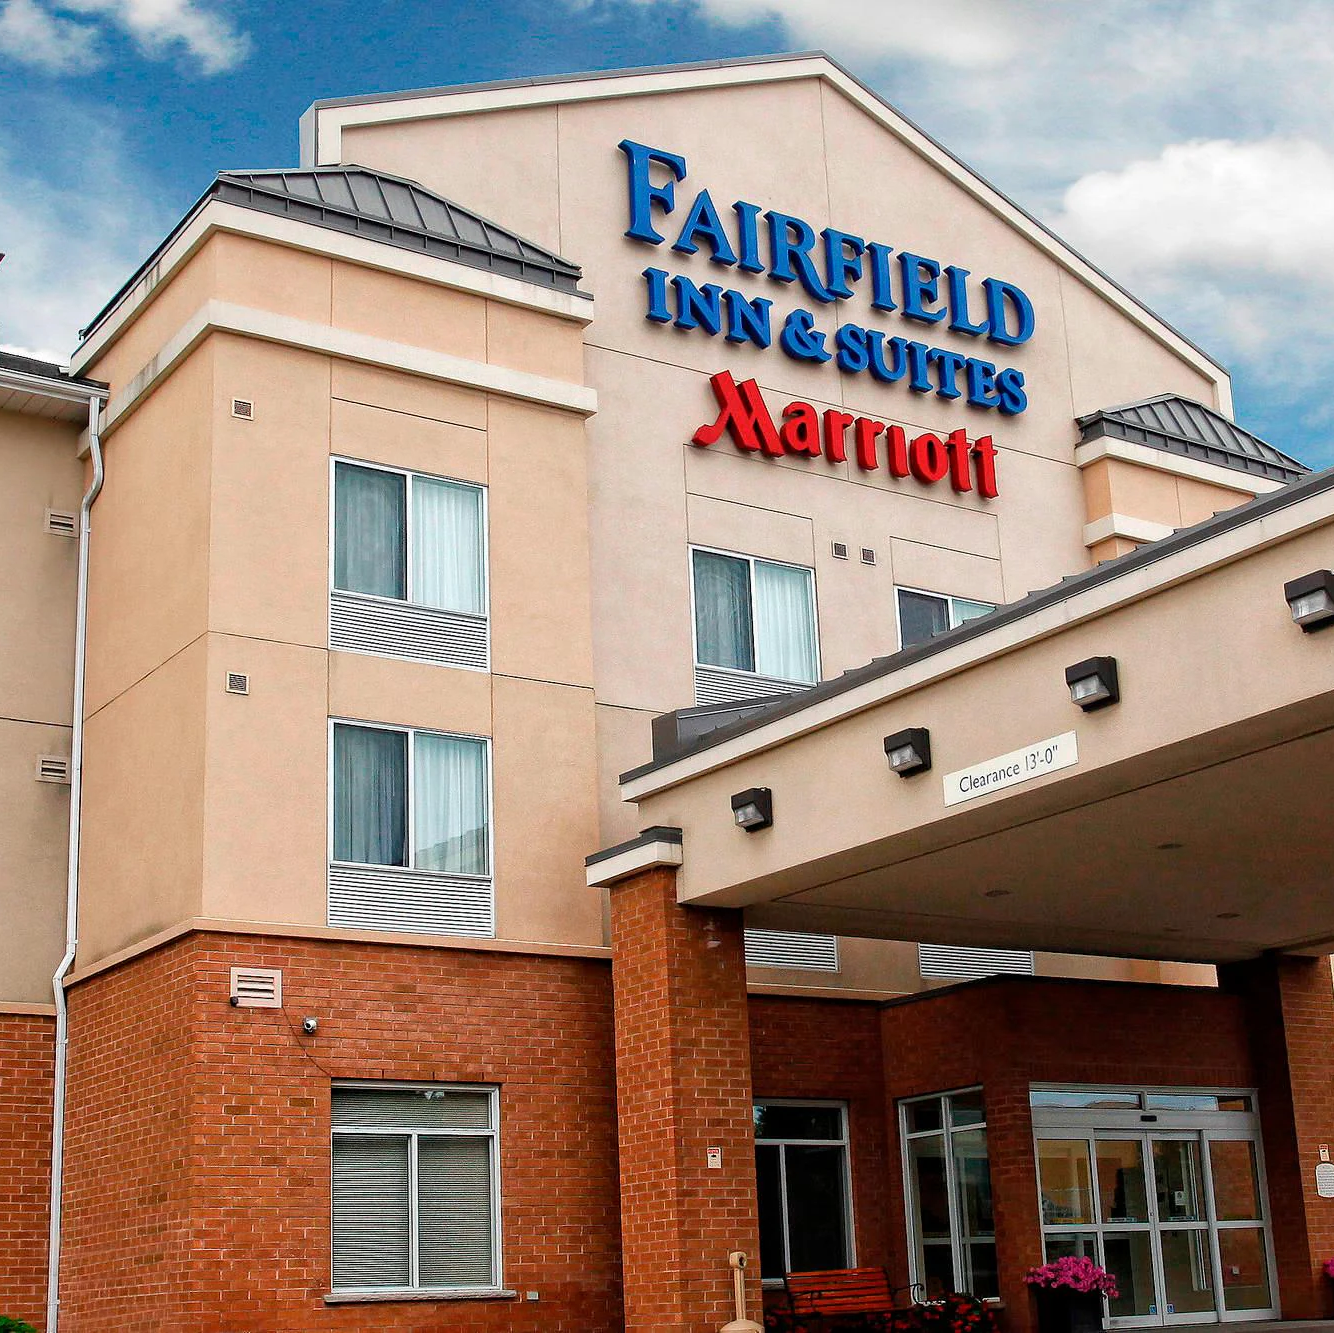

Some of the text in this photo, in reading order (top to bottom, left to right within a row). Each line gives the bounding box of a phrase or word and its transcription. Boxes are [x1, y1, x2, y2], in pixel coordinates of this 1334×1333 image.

[618, 138, 1036, 347] FAIRFIELD
[642, 266, 1029, 416] INN & SUITES
[692, 369, 999, 499] Marriott
[959, 744, 1058, 793] Clearance 13'-0"
